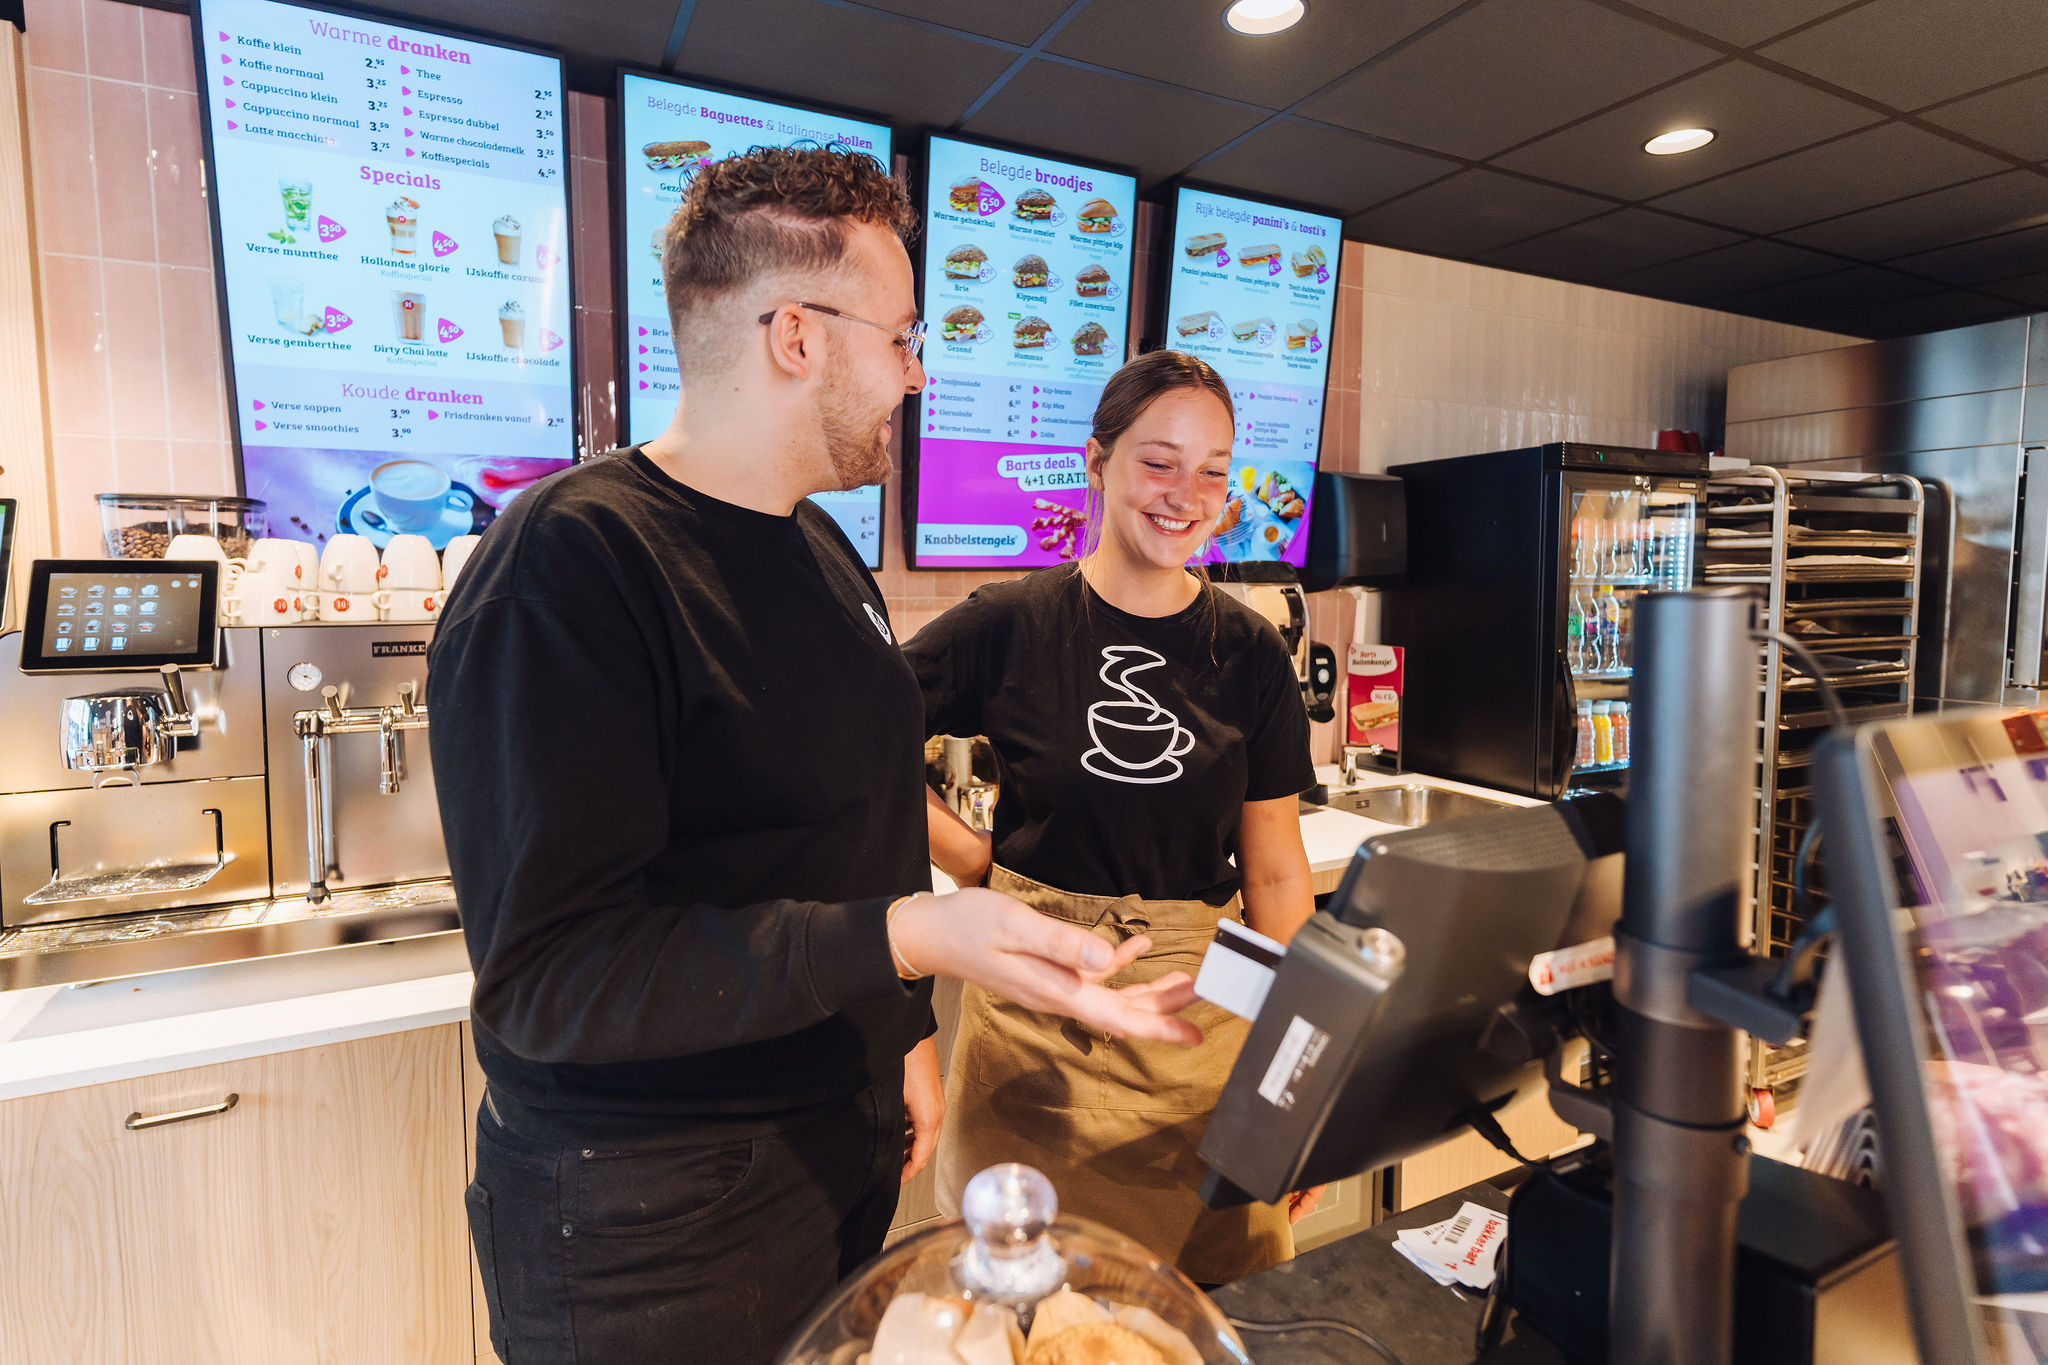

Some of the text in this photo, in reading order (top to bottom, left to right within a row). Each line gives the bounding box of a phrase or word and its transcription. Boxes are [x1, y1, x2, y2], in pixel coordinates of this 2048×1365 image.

[237, 35, 271, 50] Koffie
[273, 42, 302, 55] klein
[309, 19, 472, 65] Warme dranken
[239, 58, 273, 72] Koffie
[275, 65, 324, 81] normaal
[416, 68, 442, 81] Thee
[241, 80, 308, 101] Cappuccino
[310, 90, 338, 104] klein
[417, 90, 463, 106] Espresso
[242, 102, 310, 122] Cappuccino
[312, 112, 359, 128] normaal
[419, 109, 464, 126] Espresso
[466, 116, 500, 132] dubbel
[647, 96, 873, 150] Belegde Baguettes & Italiaanse bollen
[244, 122, 275, 135] Latte
[420, 130, 455, 145] Warme
[457, 136, 525, 156] chocolademelk
[421, 151, 490, 170] Koffiespecials
[360, 165, 441, 191] Specials
[980, 158, 1093, 193] Belegde broodjes
[979, 197, 1000, 213] 6.50
[933, 211, 959, 222] Warme
[1196, 202, 1326, 237] Rijk belegde panini's & tosti's
[320, 223, 341, 239] 3.50
[1008, 223, 1033, 234] Warme
[434, 238, 455, 254] 4.50
[1069, 234, 1092, 245] Warme
[246, 242, 339, 261] Verse muntthee
[361, 255, 451, 275] Hollandse glorie
[954, 284, 969, 292] Brie
[1015, 293, 1047, 304] Kippendij
[327, 313, 348, 328] 3.50
[440, 325, 459, 341] 4.50
[247, 333, 352, 351] Verse gemberthee
[374, 344, 448, 358] Dirty Chai latte
[1014, 353, 1044, 361] Hummus
[1073, 359, 1104, 368] Carpaccio
[342, 382, 484, 406] Koude dranken
[653, 382, 667, 391] Kip
[271, 401, 301, 412] Verse
[303, 404, 342, 415] sappen
[939, 409, 972, 417] Eiersalade
[444, 410, 502, 423] Frisdranken
[504, 415, 532, 424] vanaf
[273, 421, 303, 431] Verse
[305, 422, 359, 434] smoothies
[1006, 457, 1076, 471] Barts deals
[1024, 475, 1045, 486] 4+1
[924, 534, 1016, 548] Knabbelstengels
[373, 644, 426, 654] FRANKE
